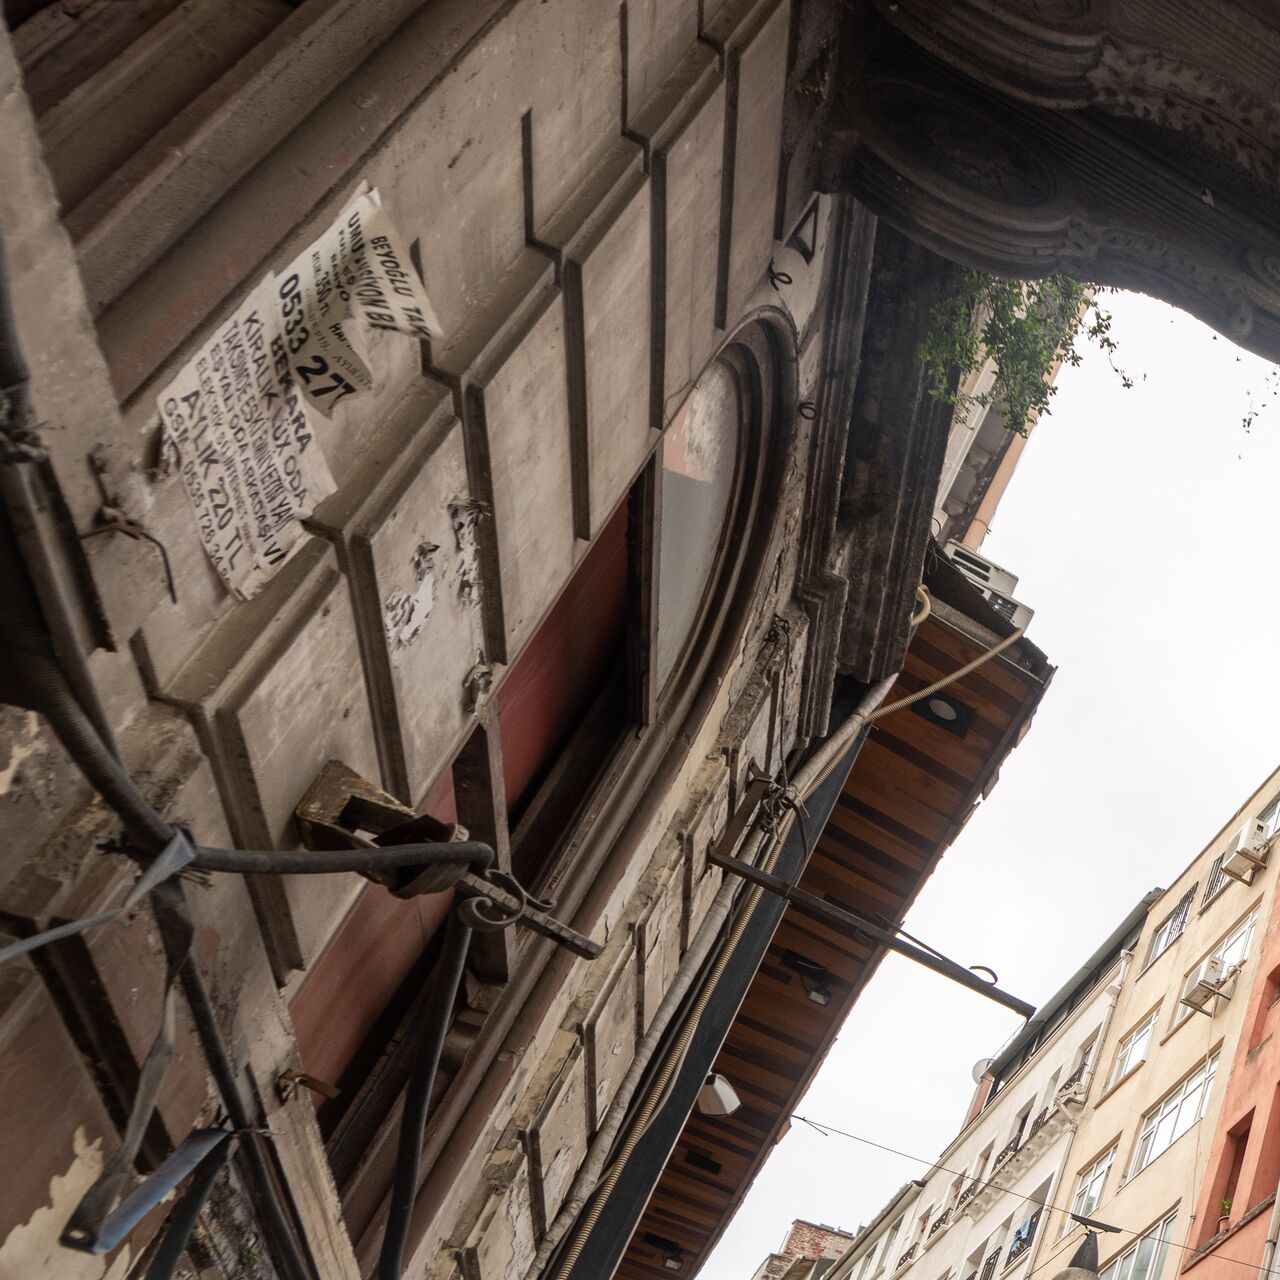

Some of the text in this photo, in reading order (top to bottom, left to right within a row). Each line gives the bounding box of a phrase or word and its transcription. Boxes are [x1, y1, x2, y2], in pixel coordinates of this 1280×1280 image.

[279, 272, 309, 354] 0533
[180, 389, 220, 480] AYLIK
[207, 475, 233, 530] 220
[225, 526, 244, 571] TL
[283, 454, 307, 508] ODA
